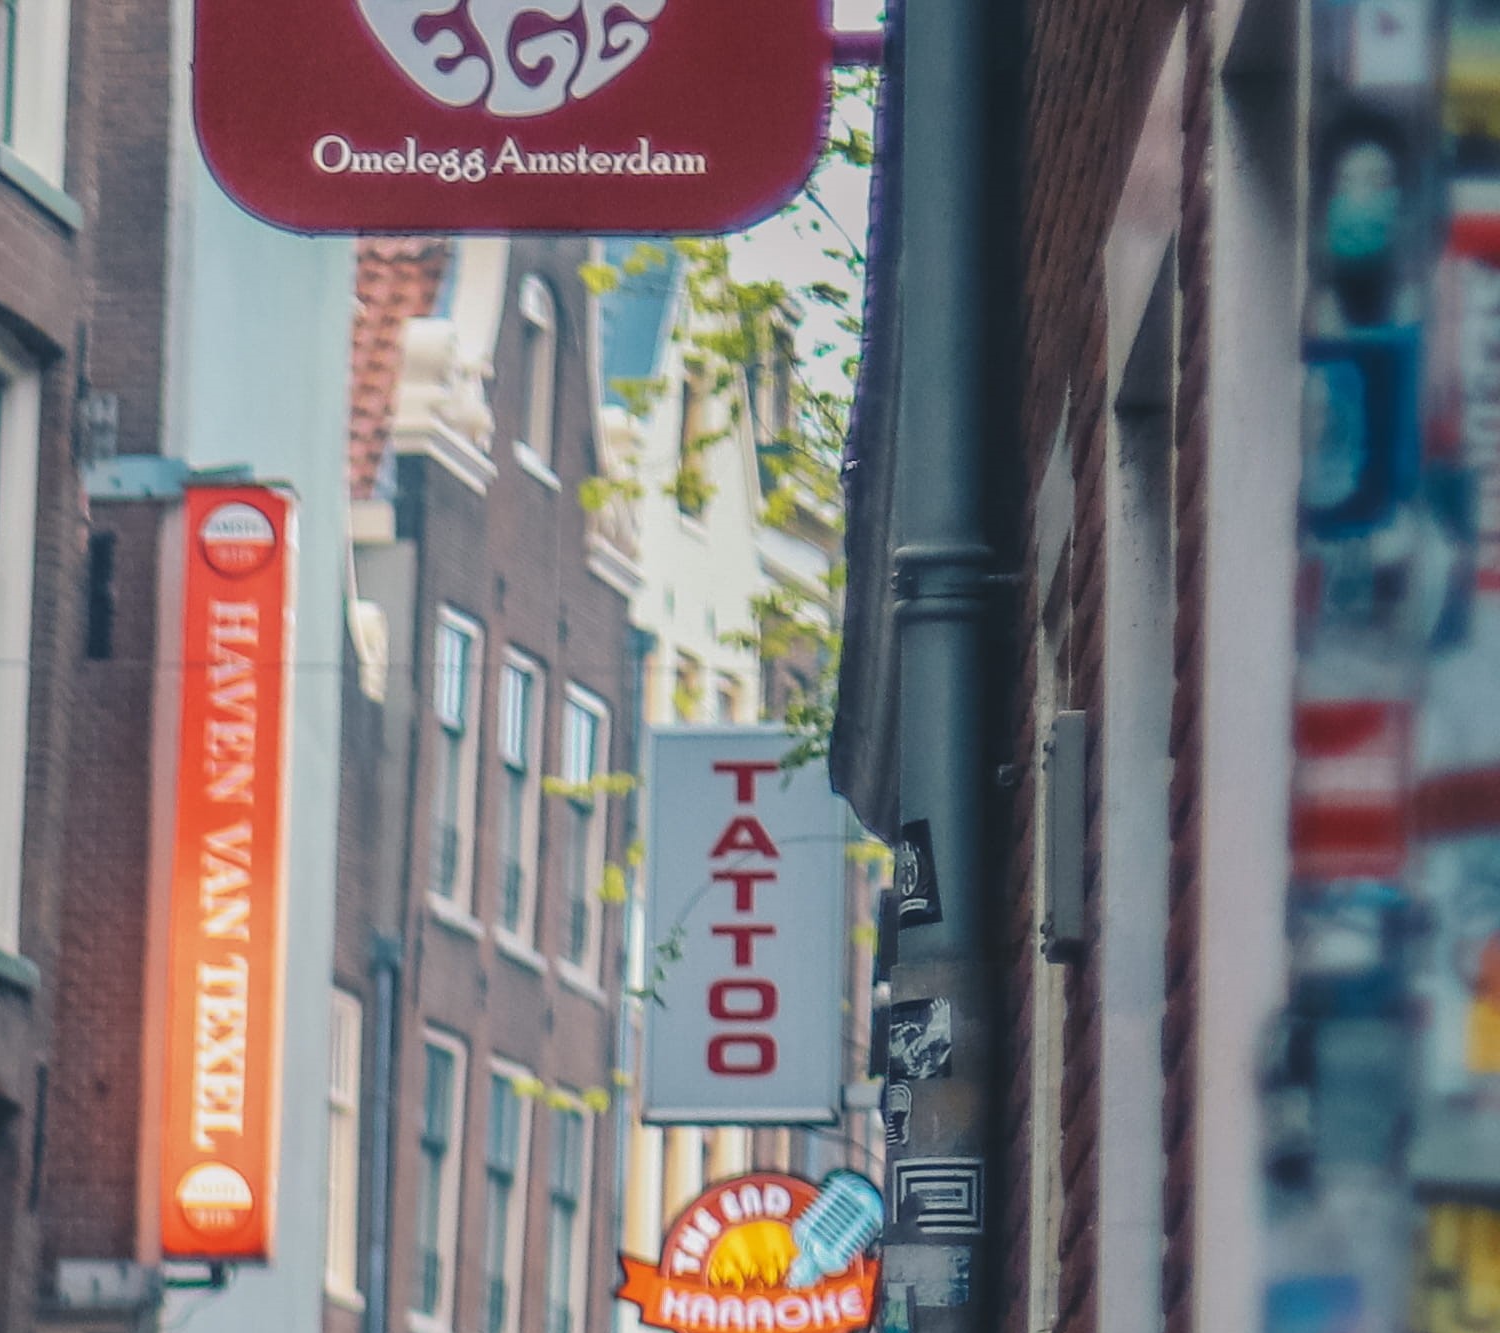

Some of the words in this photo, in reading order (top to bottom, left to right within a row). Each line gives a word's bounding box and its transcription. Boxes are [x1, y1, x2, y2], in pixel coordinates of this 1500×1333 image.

[312, 134, 487, 182] Omelegg
[491, 136, 707, 175] Amsterdam
[204, 599, 260, 804] HAVEN
[199, 823, 255, 942] VAN
[705, 762, 779, 1078] TATTOO
[191, 955, 250, 1153] TEXEL
[672, 1199, 720, 1277] THE
[659, 1284, 865, 1333] KARAOKE
